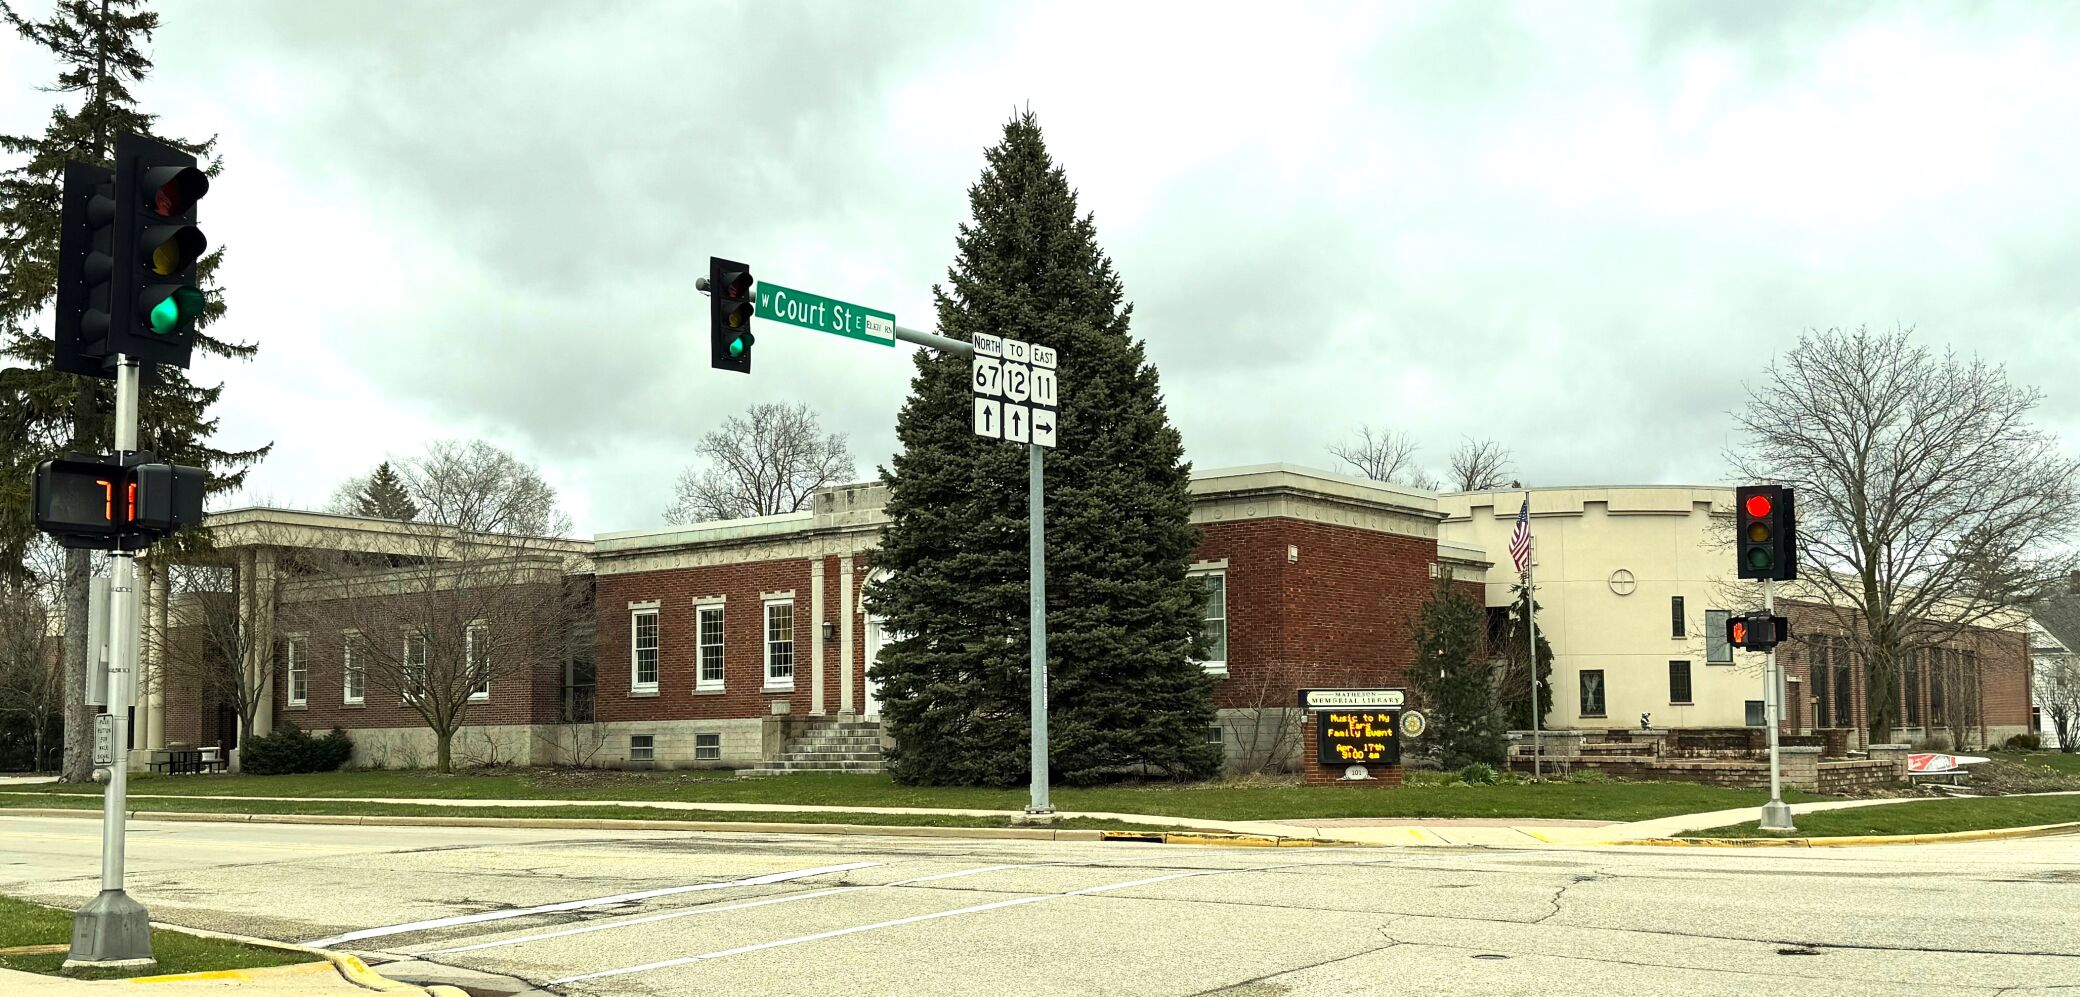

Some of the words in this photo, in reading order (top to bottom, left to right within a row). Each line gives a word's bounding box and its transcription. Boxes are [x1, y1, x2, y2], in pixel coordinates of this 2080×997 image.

[761, 293, 770, 308] W
[774, 291, 826, 327] Court
[832, 305, 852, 333] St
[855, 315, 862, 329] E
[974, 335, 1001, 353] NORTH
[1009, 344, 1024, 357] TO
[1034, 348, 1054, 364] EAST
[976, 365, 999, 389] 67
[1008, 370, 1025, 394] 12
[1037, 375, 1050, 399] 11
[1330, 714, 1358, 722] Music
[1363, 714, 1374, 722] to
[1378, 714, 1390, 722] My
[1349, 721, 1371, 729] Ears
[1328, 729, 1361, 737] Family
[1365, 729, 1393, 737] Event
[1364, 743, 1385, 752] 17th
